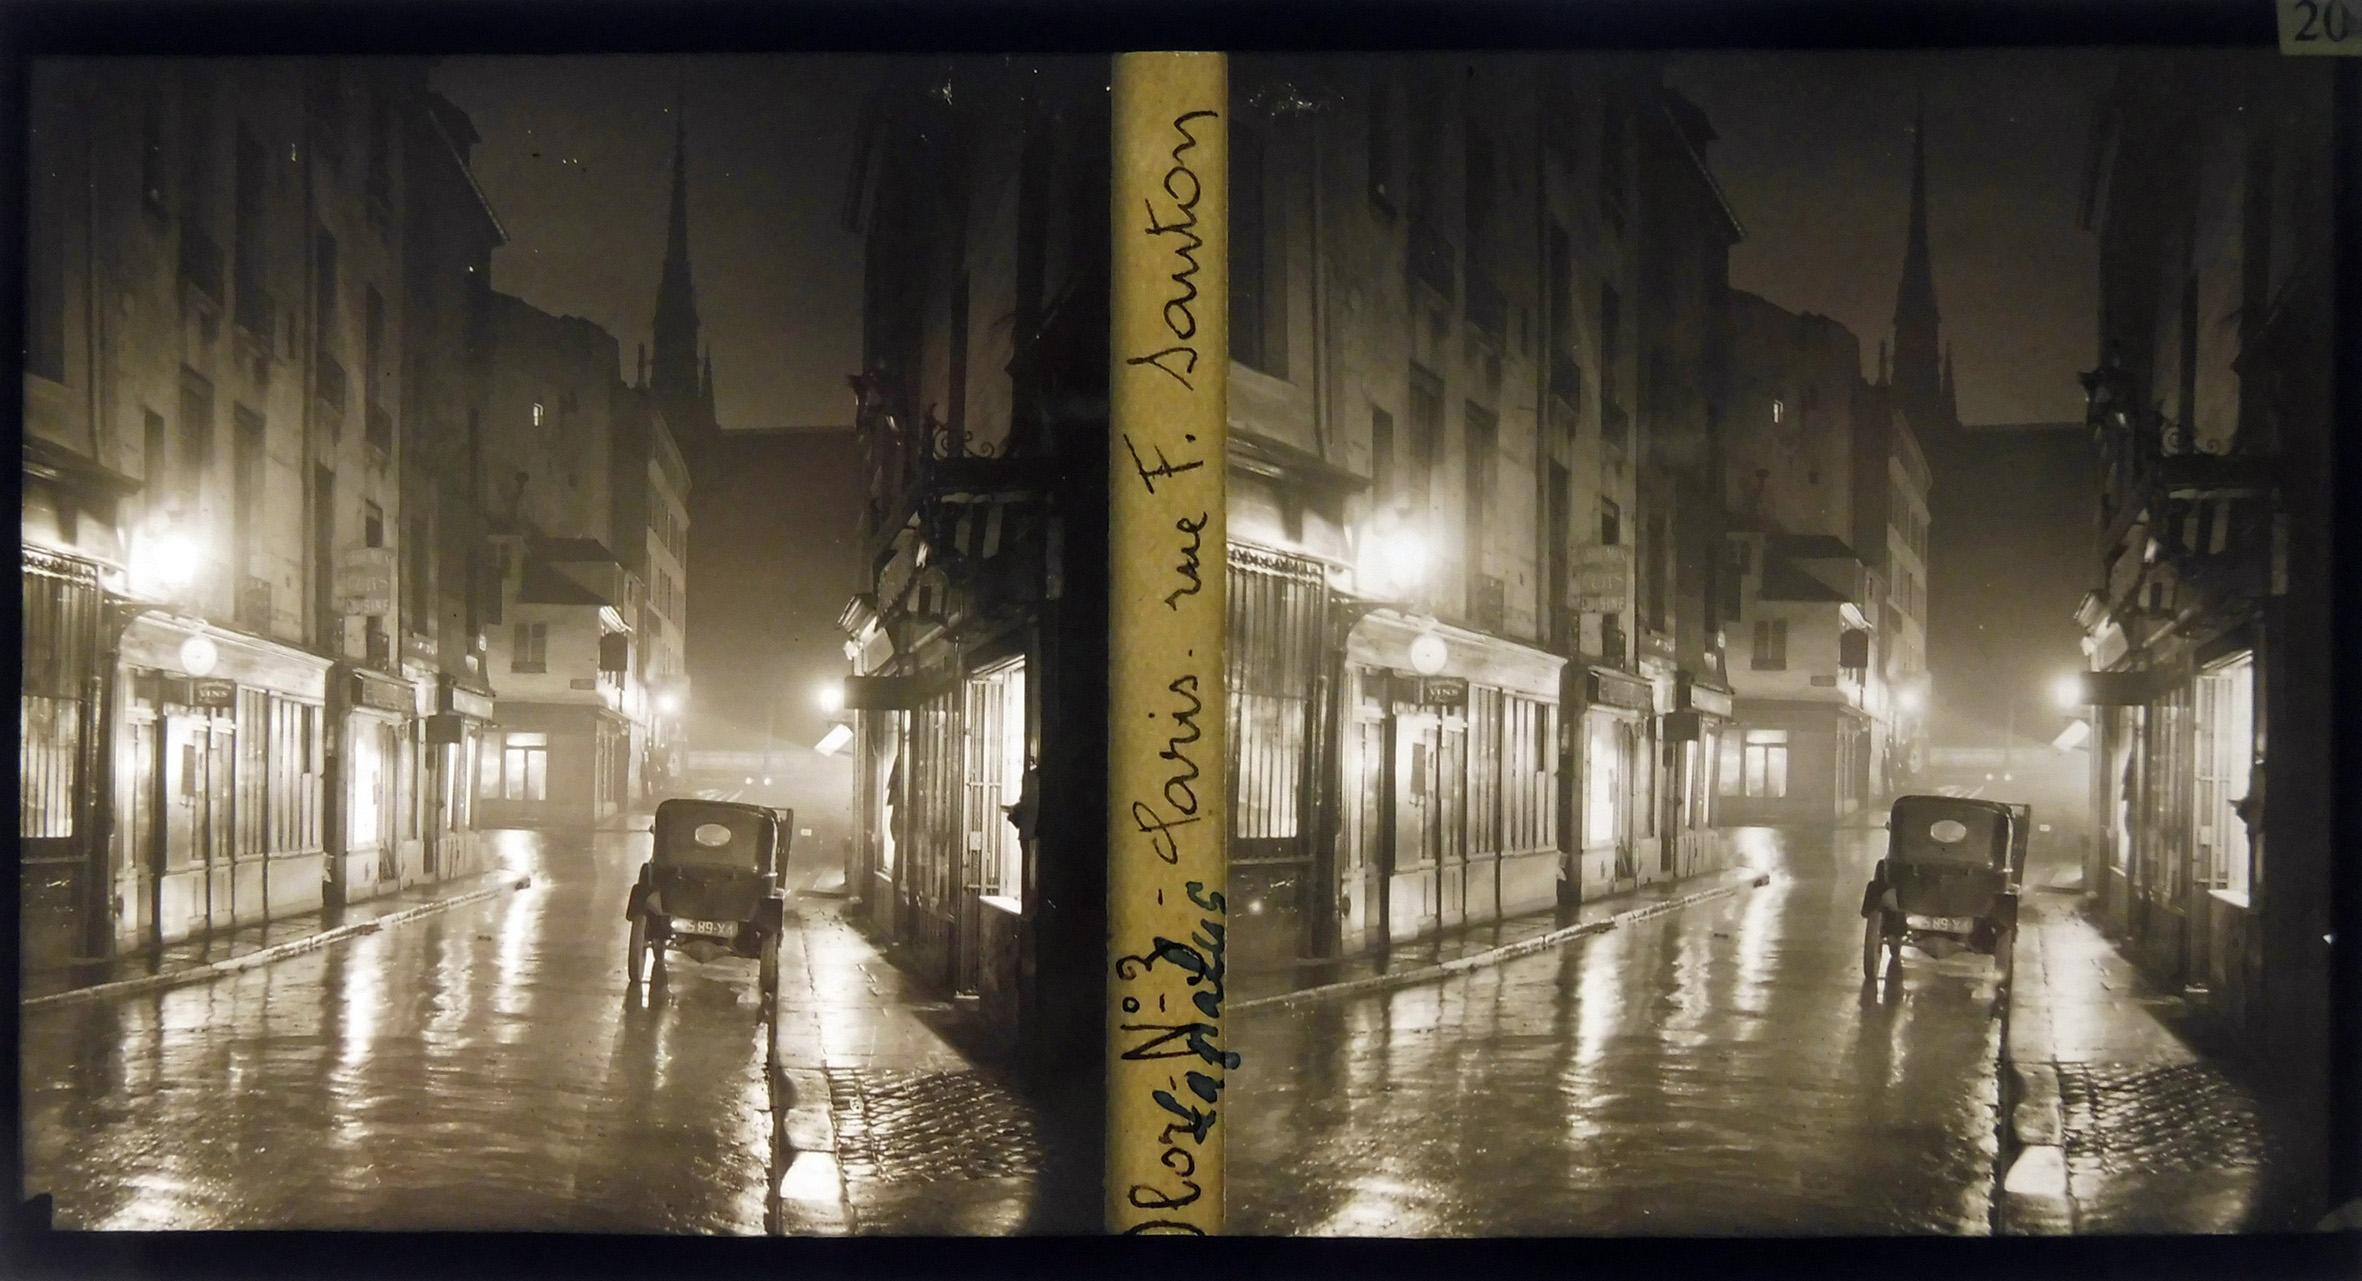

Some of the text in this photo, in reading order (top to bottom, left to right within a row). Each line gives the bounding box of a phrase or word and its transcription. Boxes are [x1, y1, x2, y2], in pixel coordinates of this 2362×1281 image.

[1122, 432, 1204, 495] F.
[1163, 511, 1208, 612] rue
[199, 688, 228, 698] VINS
